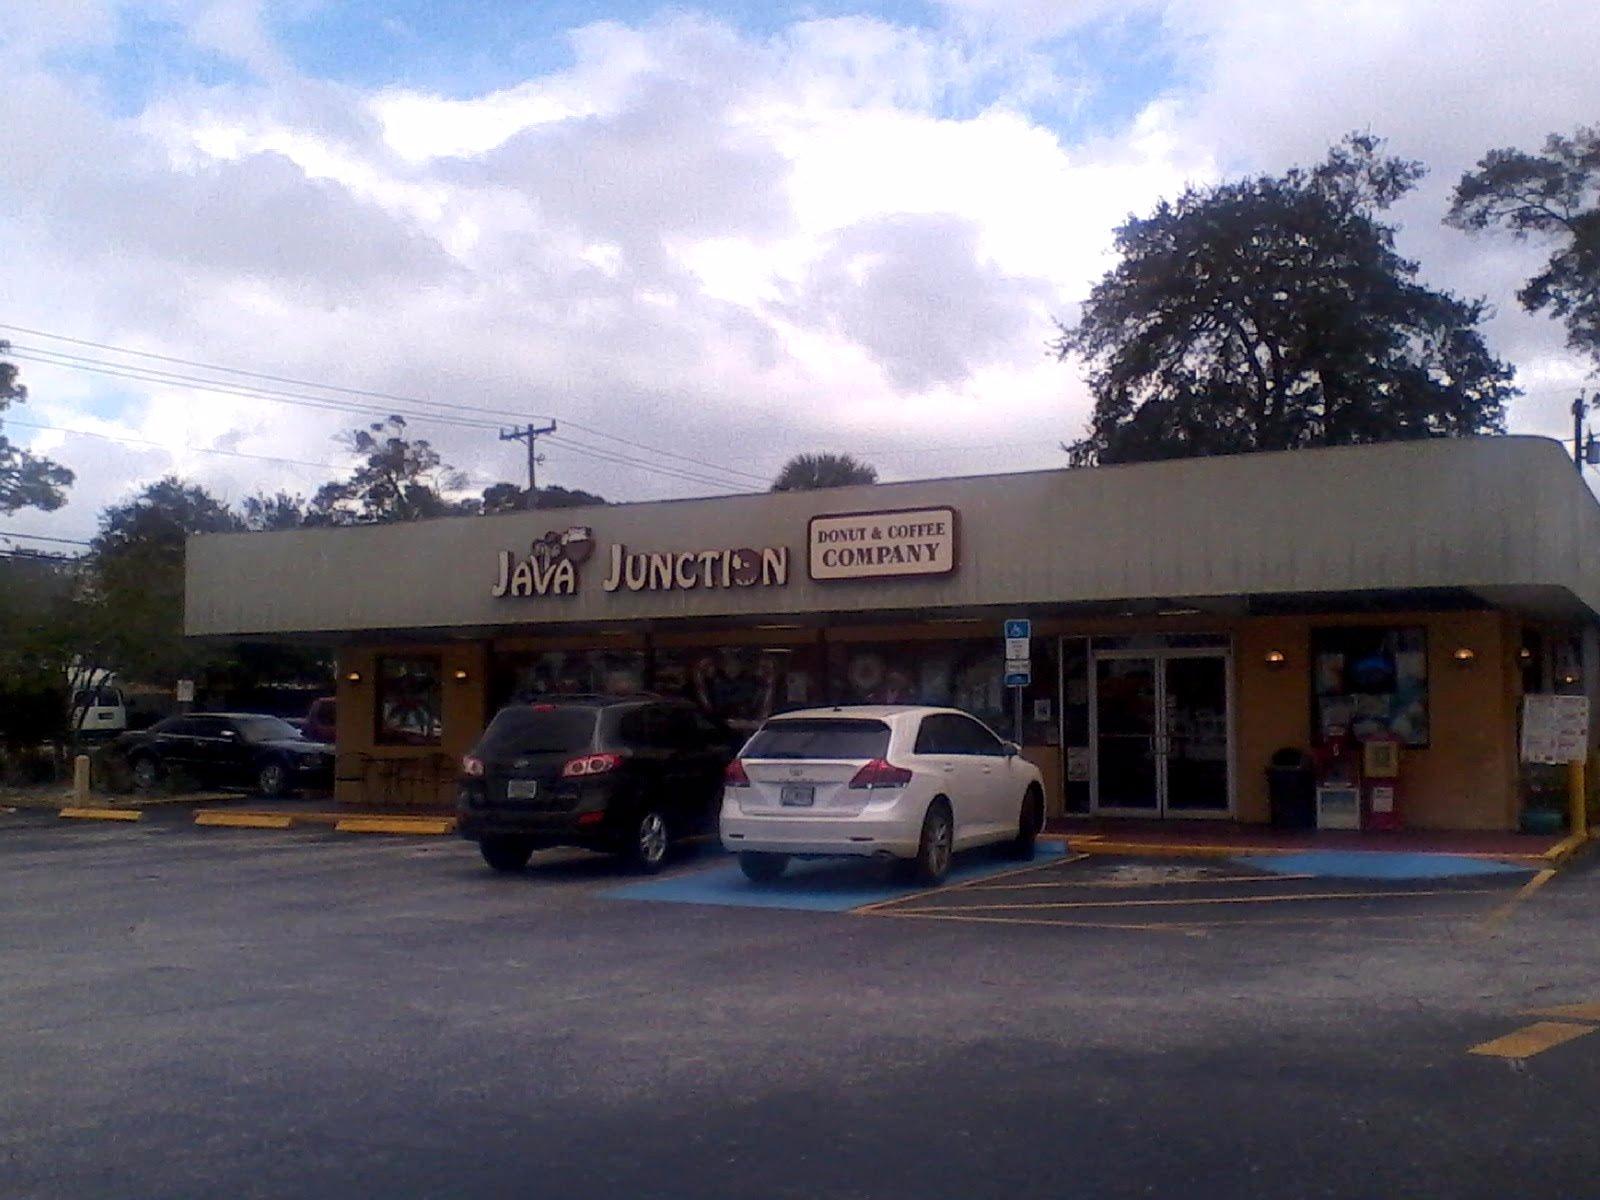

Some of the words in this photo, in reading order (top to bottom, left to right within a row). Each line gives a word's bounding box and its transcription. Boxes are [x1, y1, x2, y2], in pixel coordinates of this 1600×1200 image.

[817, 527, 866, 543] DONUT
[871, 526, 882, 540] &
[887, 522, 945, 539] COFFEE
[822, 543, 940, 568] COMPANY
[491, 550, 577, 597] JAVA
[602, 543, 788, 591] JUNCTION
